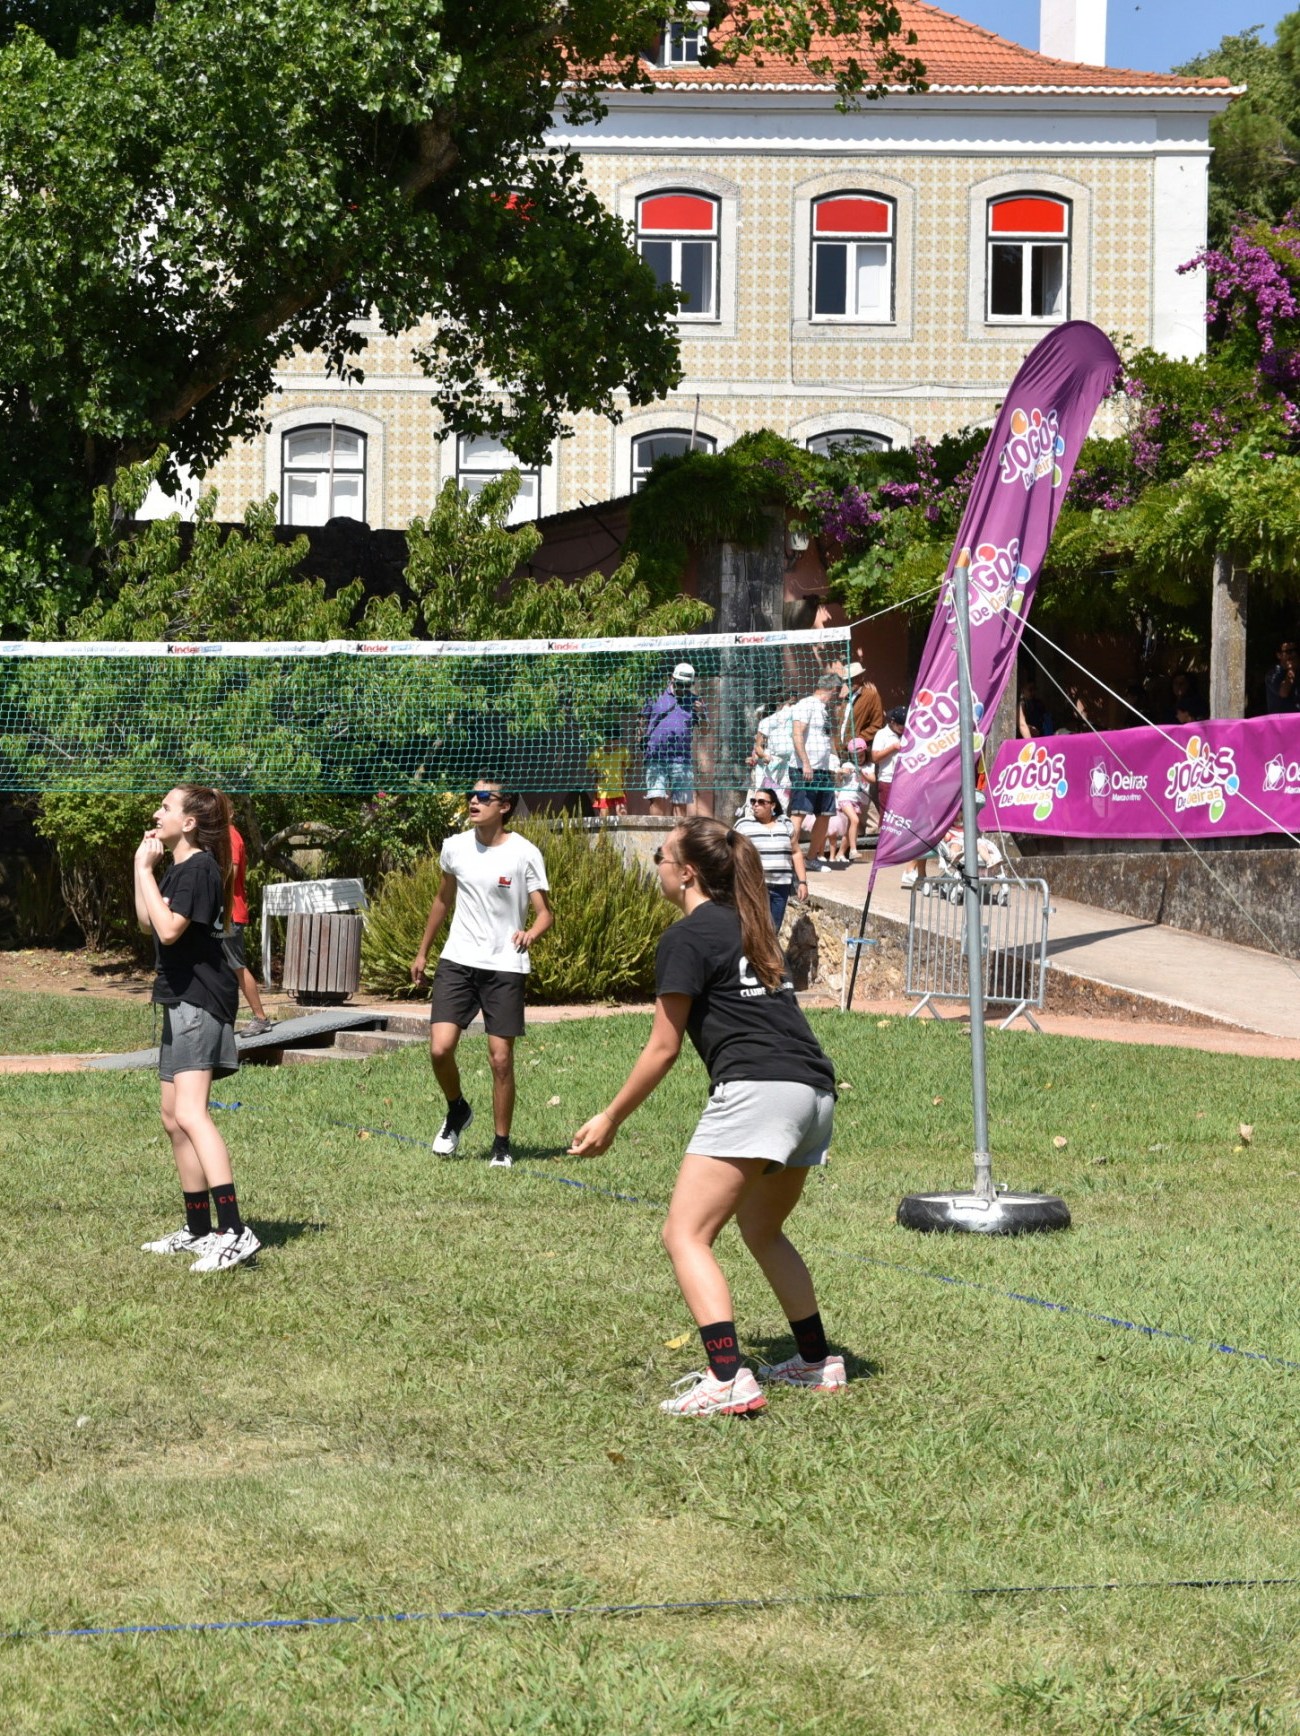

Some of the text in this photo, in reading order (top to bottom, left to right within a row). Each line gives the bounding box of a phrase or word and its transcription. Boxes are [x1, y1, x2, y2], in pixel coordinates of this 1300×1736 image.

[969, 606, 991, 622] De
[904, 753, 927, 770] De
[994, 753, 1066, 796] JOGOS
[1111, 770, 1149, 790] Oeiras
[1001, 791, 1051, 804] De Oeiras
[706, 1336, 734, 1351] CVO
